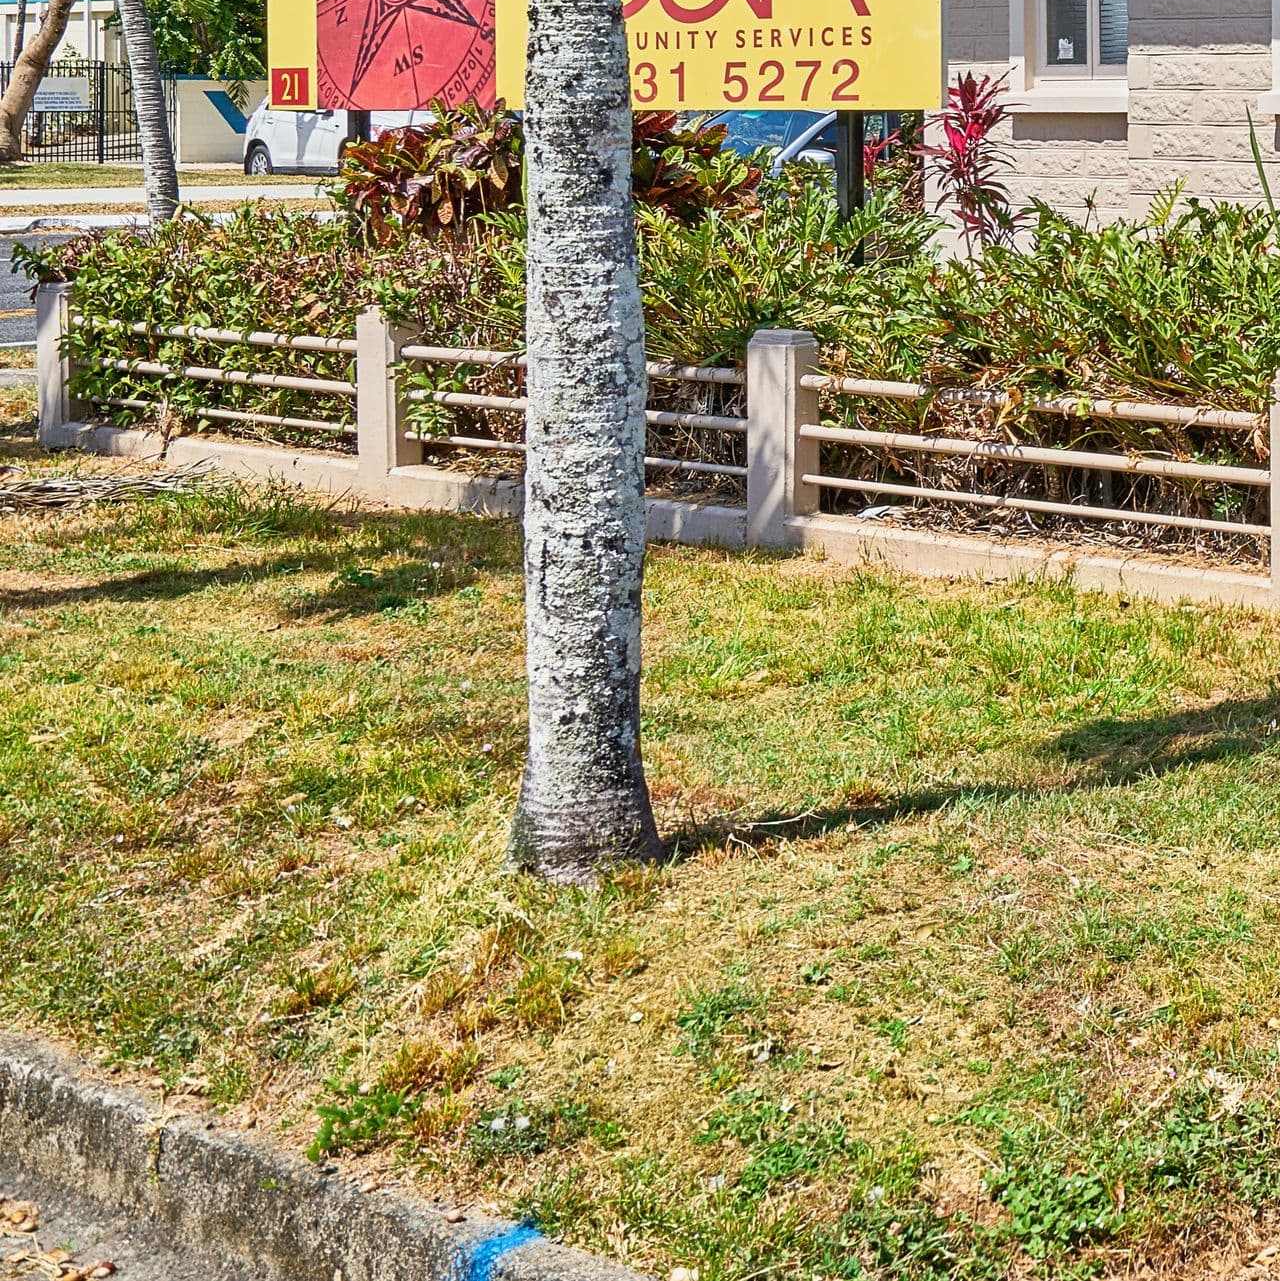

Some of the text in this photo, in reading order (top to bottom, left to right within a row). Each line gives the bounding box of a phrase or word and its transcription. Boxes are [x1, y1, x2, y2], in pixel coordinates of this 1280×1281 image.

[625, 25, 873, 51] UNITY SERVICES
[280, 72, 300, 102] 21
[633, 58, 861, 103] 31 5272
